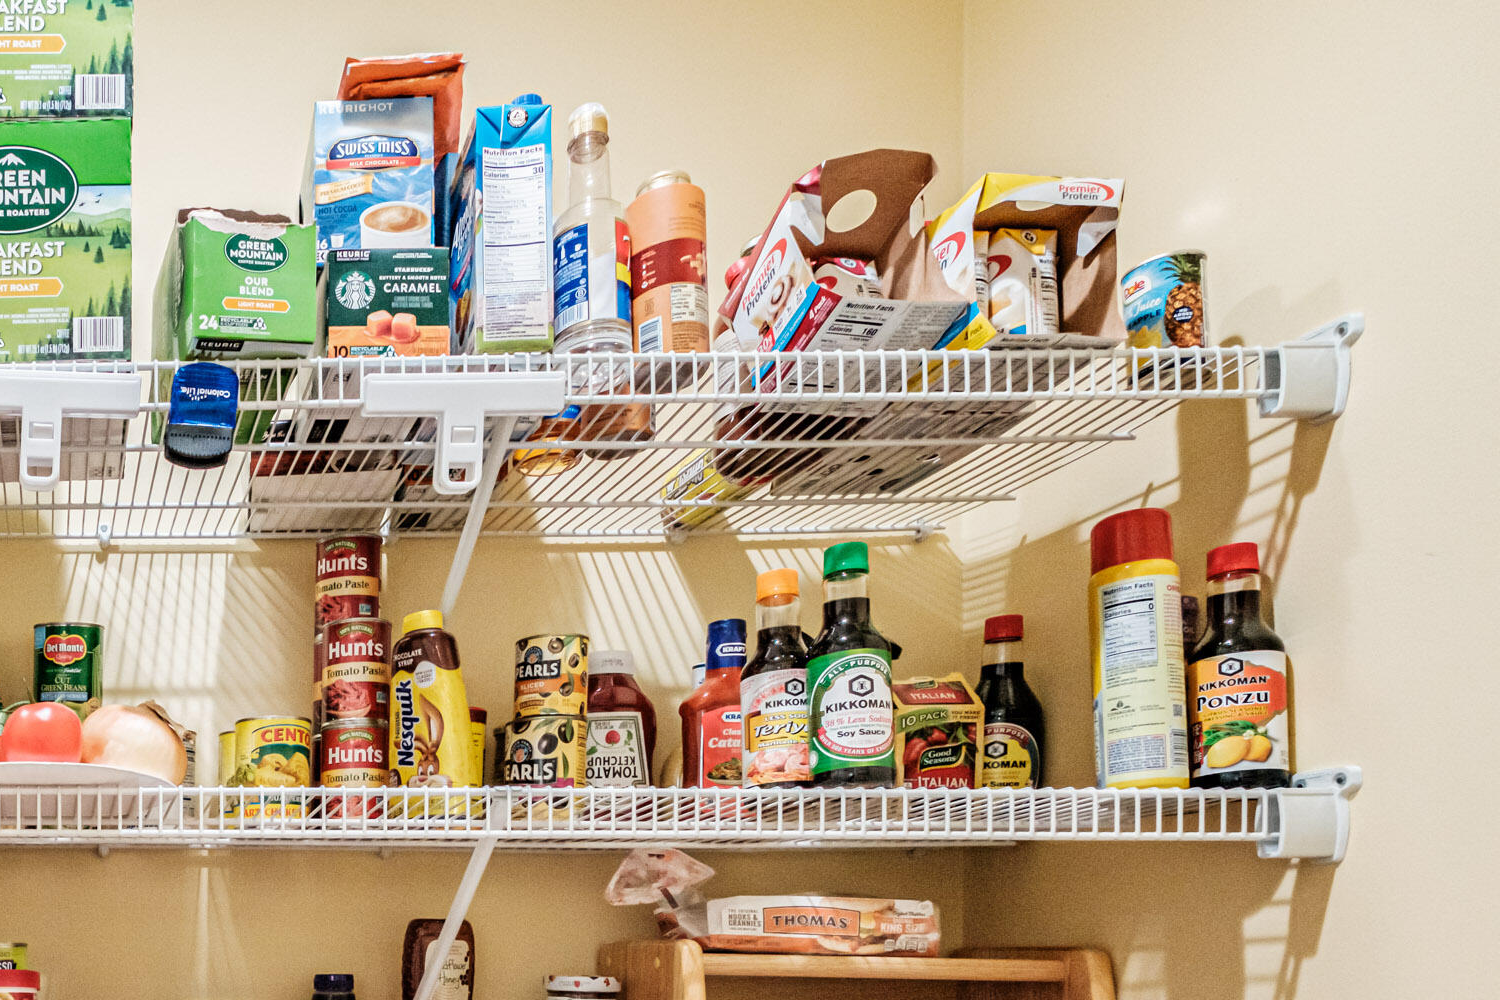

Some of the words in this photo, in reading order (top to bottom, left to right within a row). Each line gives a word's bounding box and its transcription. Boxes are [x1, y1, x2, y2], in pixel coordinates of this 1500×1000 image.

[13, 40, 42, 48] ROAST
[336, 141, 375, 159] SWISS
[377, 140, 410, 155] MISS
[484, 148, 517, 156] Nutrition
[520, 146, 543, 154] Facts
[533, 166, 544, 175] 30
[1058, 184, 1100, 194] Premier
[1062, 191, 1099, 200] Protein
[238, 240, 274, 251] GREEN
[229, 249, 284, 261] MOUNTAIN
[245, 276, 268, 286] OUR
[10, 283, 39, 292] ROAST
[239, 285, 274, 296] BLEND
[383, 283, 442, 293] CARAMEL
[199, 315, 219, 330] 24
[829, 325, 852, 333] Calories
[862, 328, 878, 336] 160
[1103, 585, 1132, 596] Nutrition
[1134, 581, 1154, 590] Facts
[327, 666, 360, 679] Tomato
[362, 665, 386, 675] Paste
[55, 676, 71, 684] CUT
[1198, 676, 1267, 693] KIKKOMAN
[41, 683, 62, 692] GREEN
[64, 683, 87, 692] BEANS
[910, 692, 956, 700] ITALIAN
[825, 699, 891, 713] KIKKOMAN
[1197, 692, 1269, 712] PONZU
[397, 679, 420, 766] Nesquik
[902, 715, 916, 728] 10
[920, 711, 948, 721] PACK
[261, 728, 311, 747] CENTO
[859, 728, 885, 736] Sauce
[587, 756, 636, 766] KETCHUP
[327, 773, 360, 784] Tomato
[362, 772, 385, 782] Paste
[585, 766, 638, 779] TOMATO
